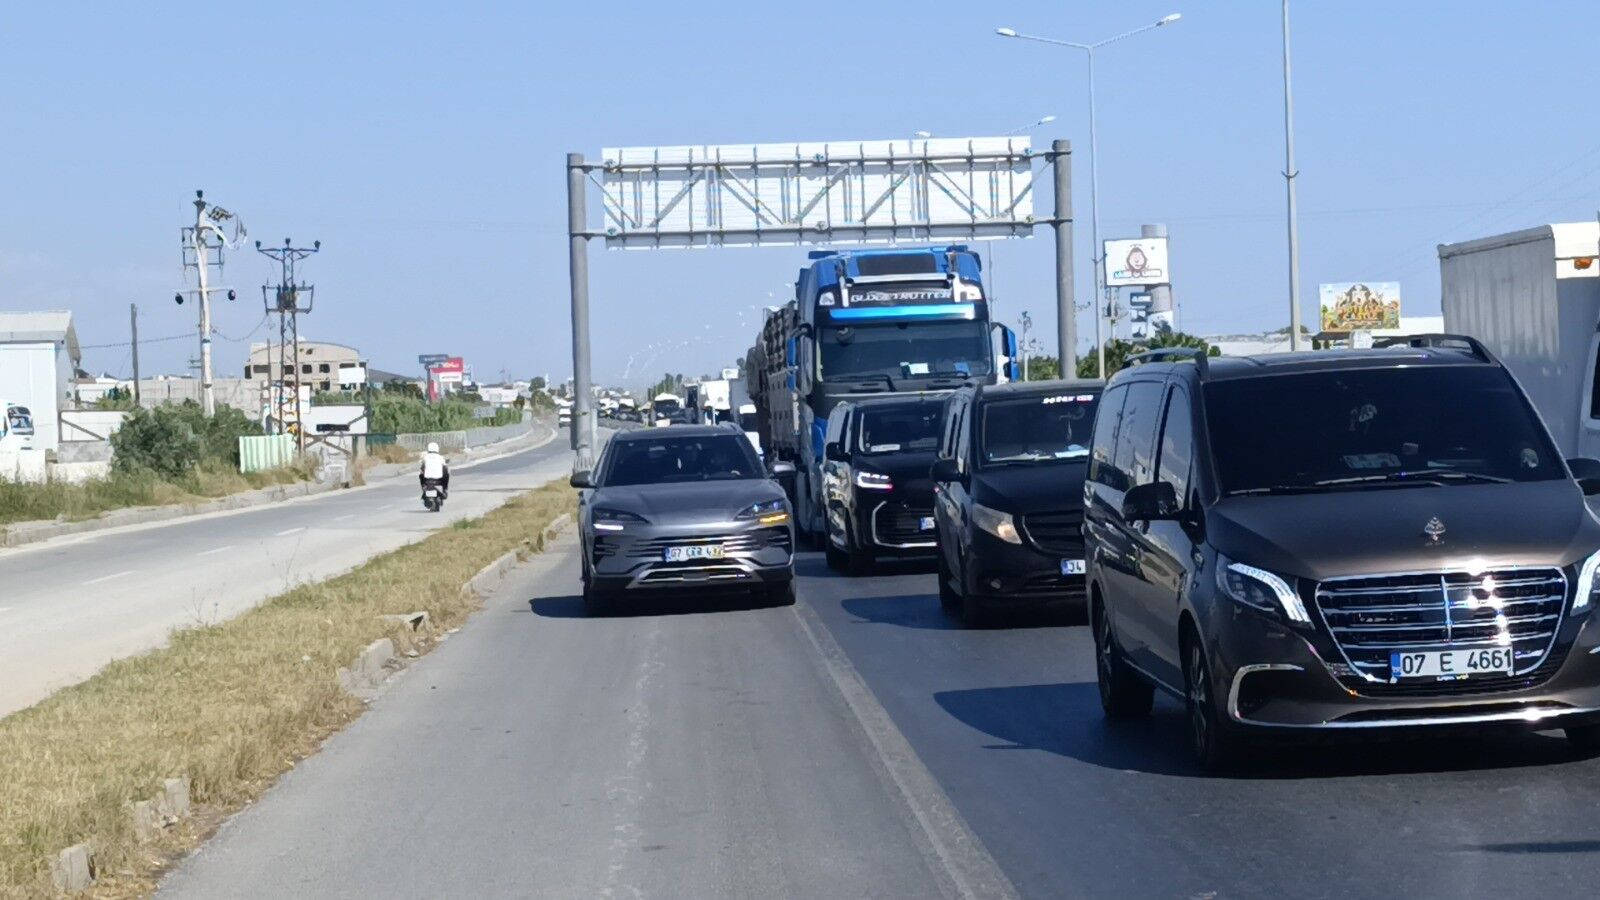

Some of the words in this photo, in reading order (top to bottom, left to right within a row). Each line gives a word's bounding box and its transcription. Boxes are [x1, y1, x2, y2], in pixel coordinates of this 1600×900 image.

[1401, 654, 1426, 674] 07
[1439, 652, 1454, 672] E
[1466, 648, 1512, 670] 4661
